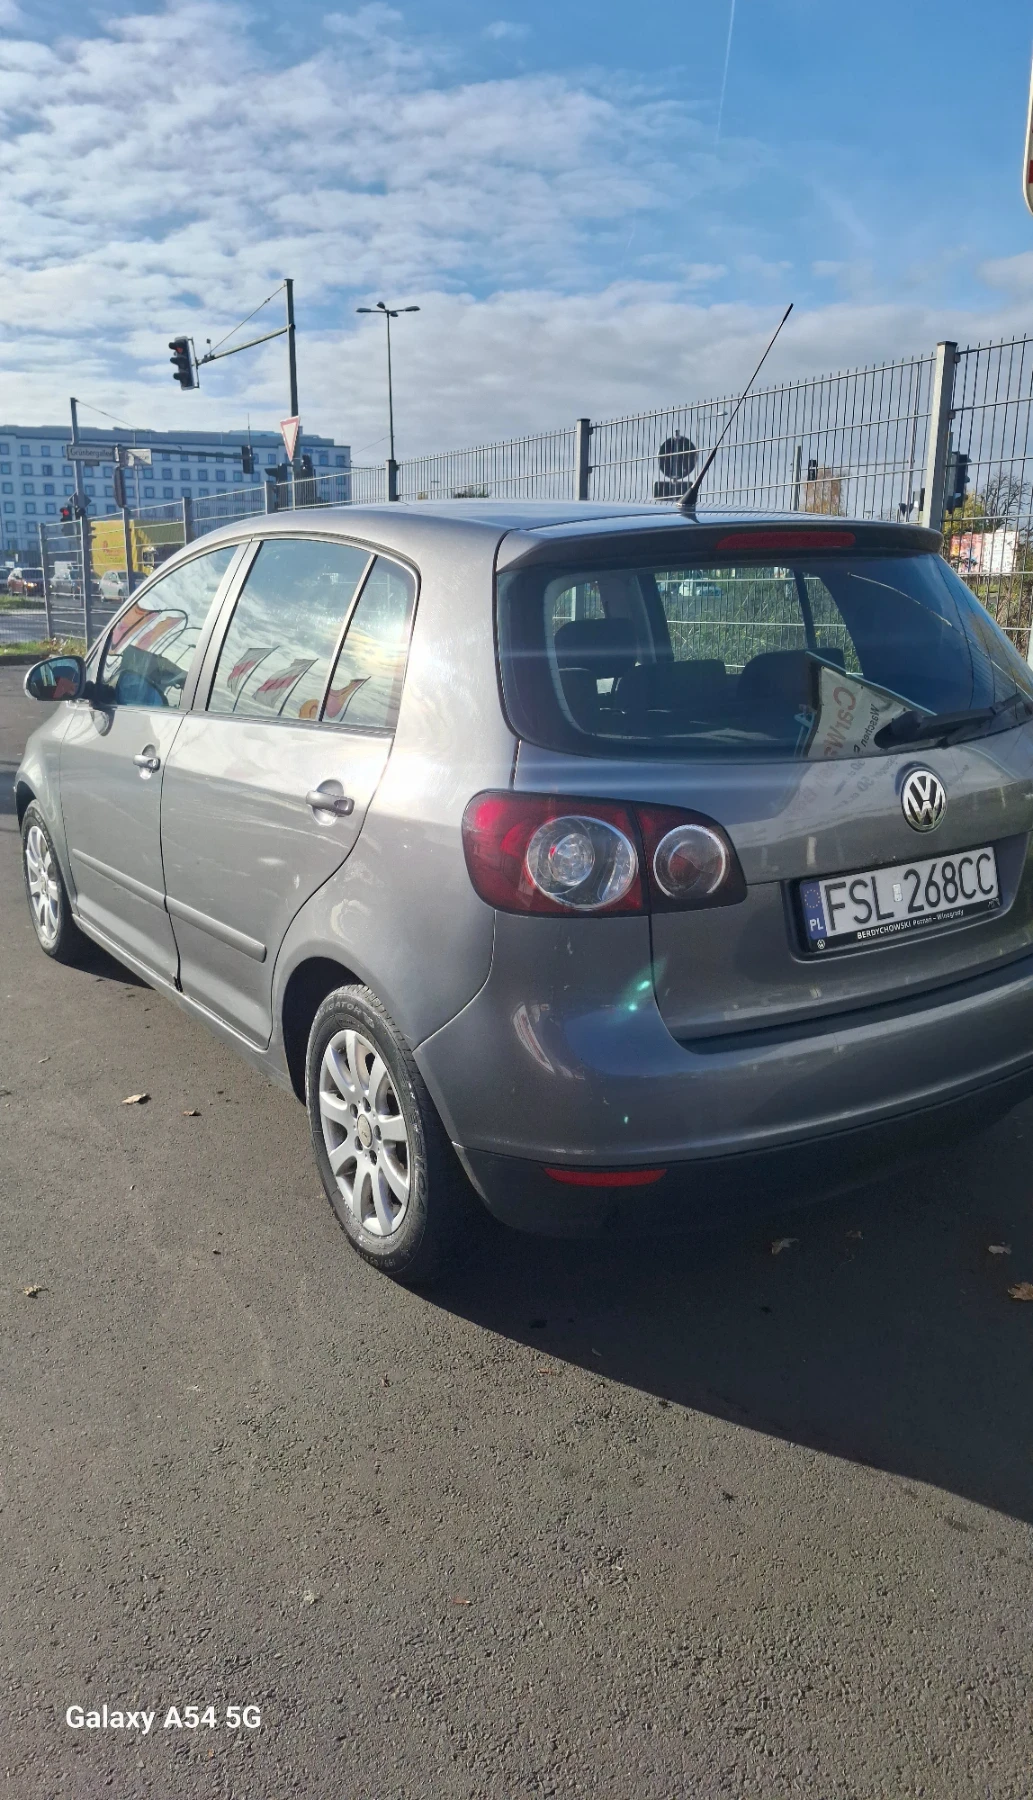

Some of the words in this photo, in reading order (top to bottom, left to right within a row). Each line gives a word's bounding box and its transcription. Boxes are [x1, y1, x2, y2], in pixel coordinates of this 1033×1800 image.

[824, 876, 895, 931] FSL
[903, 853, 994, 914] 268CC
[810, 918, 824, 931] PL
[857, 921, 911, 940] BERDYCHOWSKI
